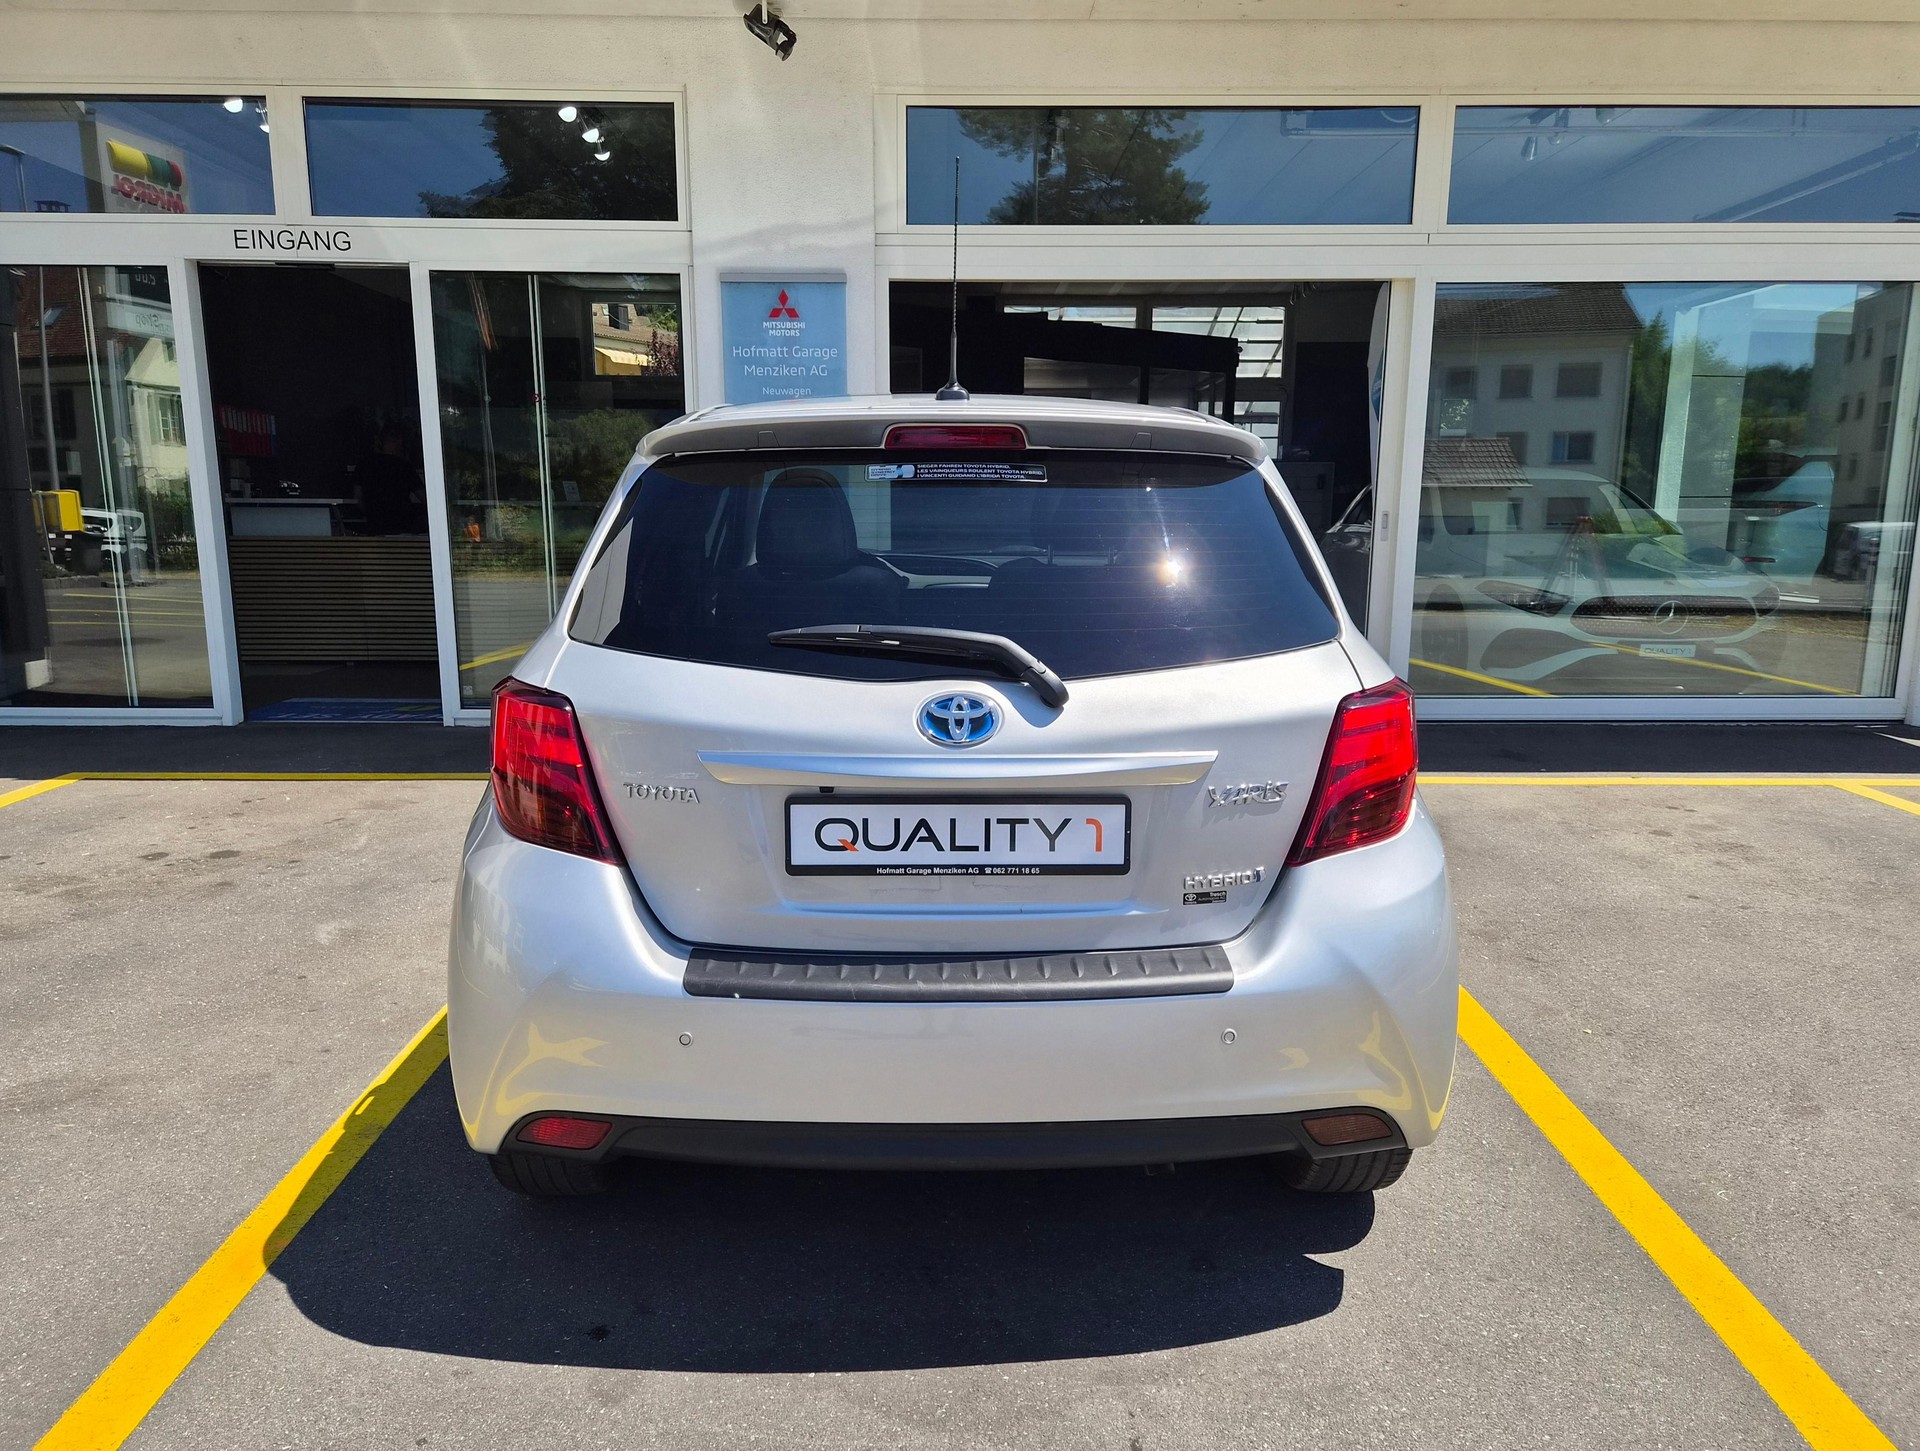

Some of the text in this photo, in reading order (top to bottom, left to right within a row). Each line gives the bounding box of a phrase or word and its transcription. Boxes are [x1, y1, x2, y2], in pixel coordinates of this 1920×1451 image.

[234, 229, 352, 252] EINGANG
[732, 345, 838, 360] Hofmatt Garage
[744, 364, 828, 376] Menziken AG
[762, 386, 812, 398] Neuwagen
[623, 782, 700, 804] TOYOTA
[814, 817, 1103, 852] QUALITY 1
[876, 867, 905, 875] Hofmatt
[906, 867, 932, 876] Garage
[1184, 872, 1252, 890] HYBRID
